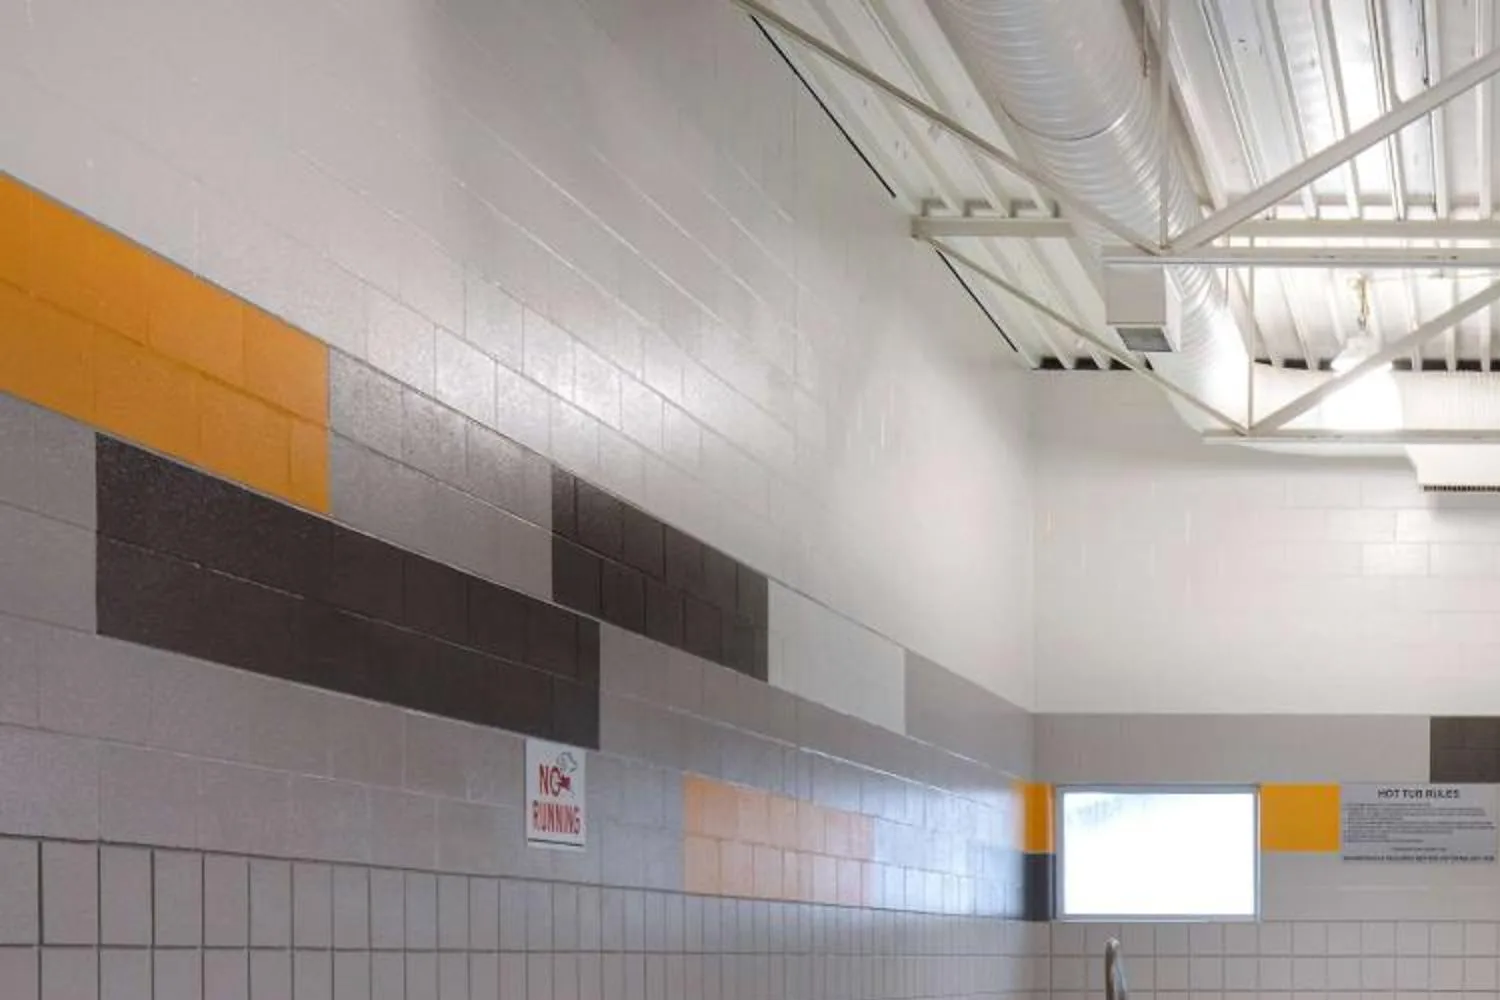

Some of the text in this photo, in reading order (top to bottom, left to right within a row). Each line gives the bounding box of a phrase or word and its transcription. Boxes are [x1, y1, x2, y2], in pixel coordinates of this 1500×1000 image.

[539, 763, 561, 797] NO
[1378, 789, 1460, 799] HOT TUB RULES
[532, 799, 581, 834] RUNNING
